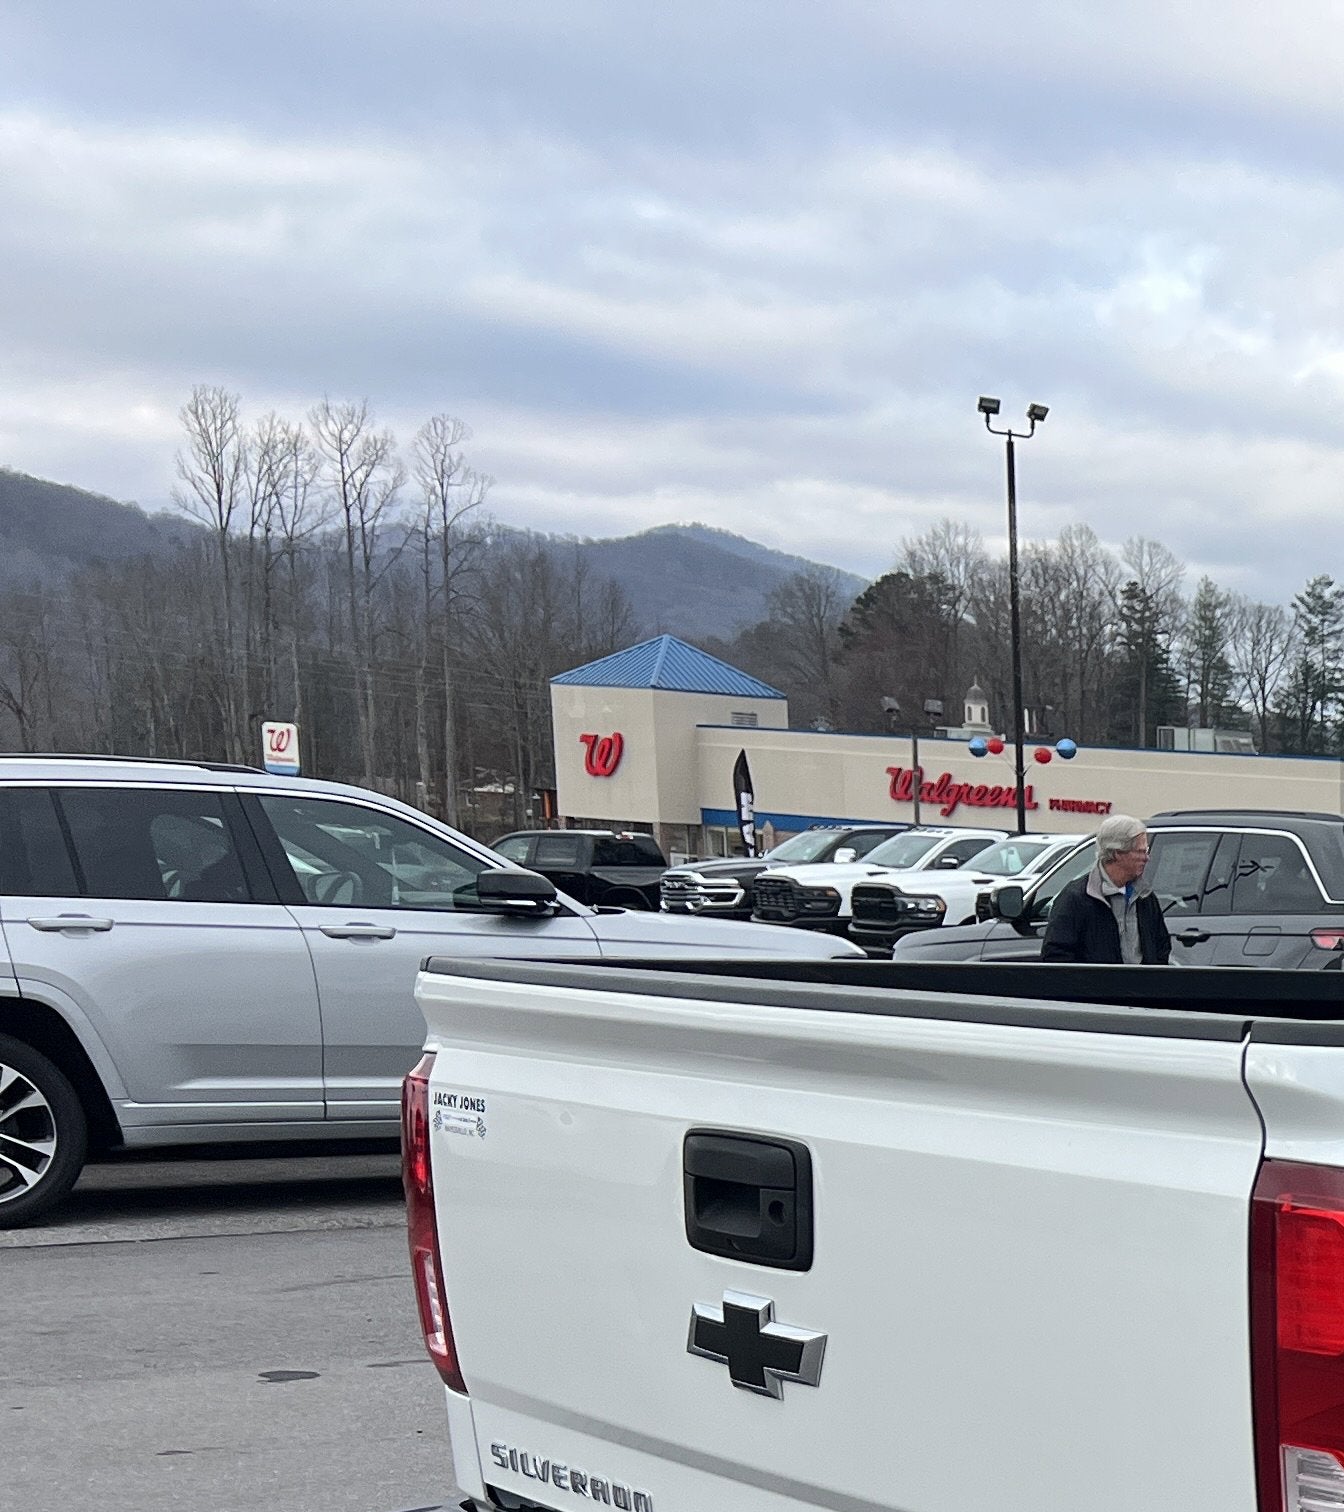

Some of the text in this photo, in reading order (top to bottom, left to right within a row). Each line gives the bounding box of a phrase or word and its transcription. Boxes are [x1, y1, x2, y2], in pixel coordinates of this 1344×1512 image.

[579, 732, 624, 777] W
[886, 765, 1038, 817] Walgreens
[433, 1092, 486, 1112] JACKY JONES
